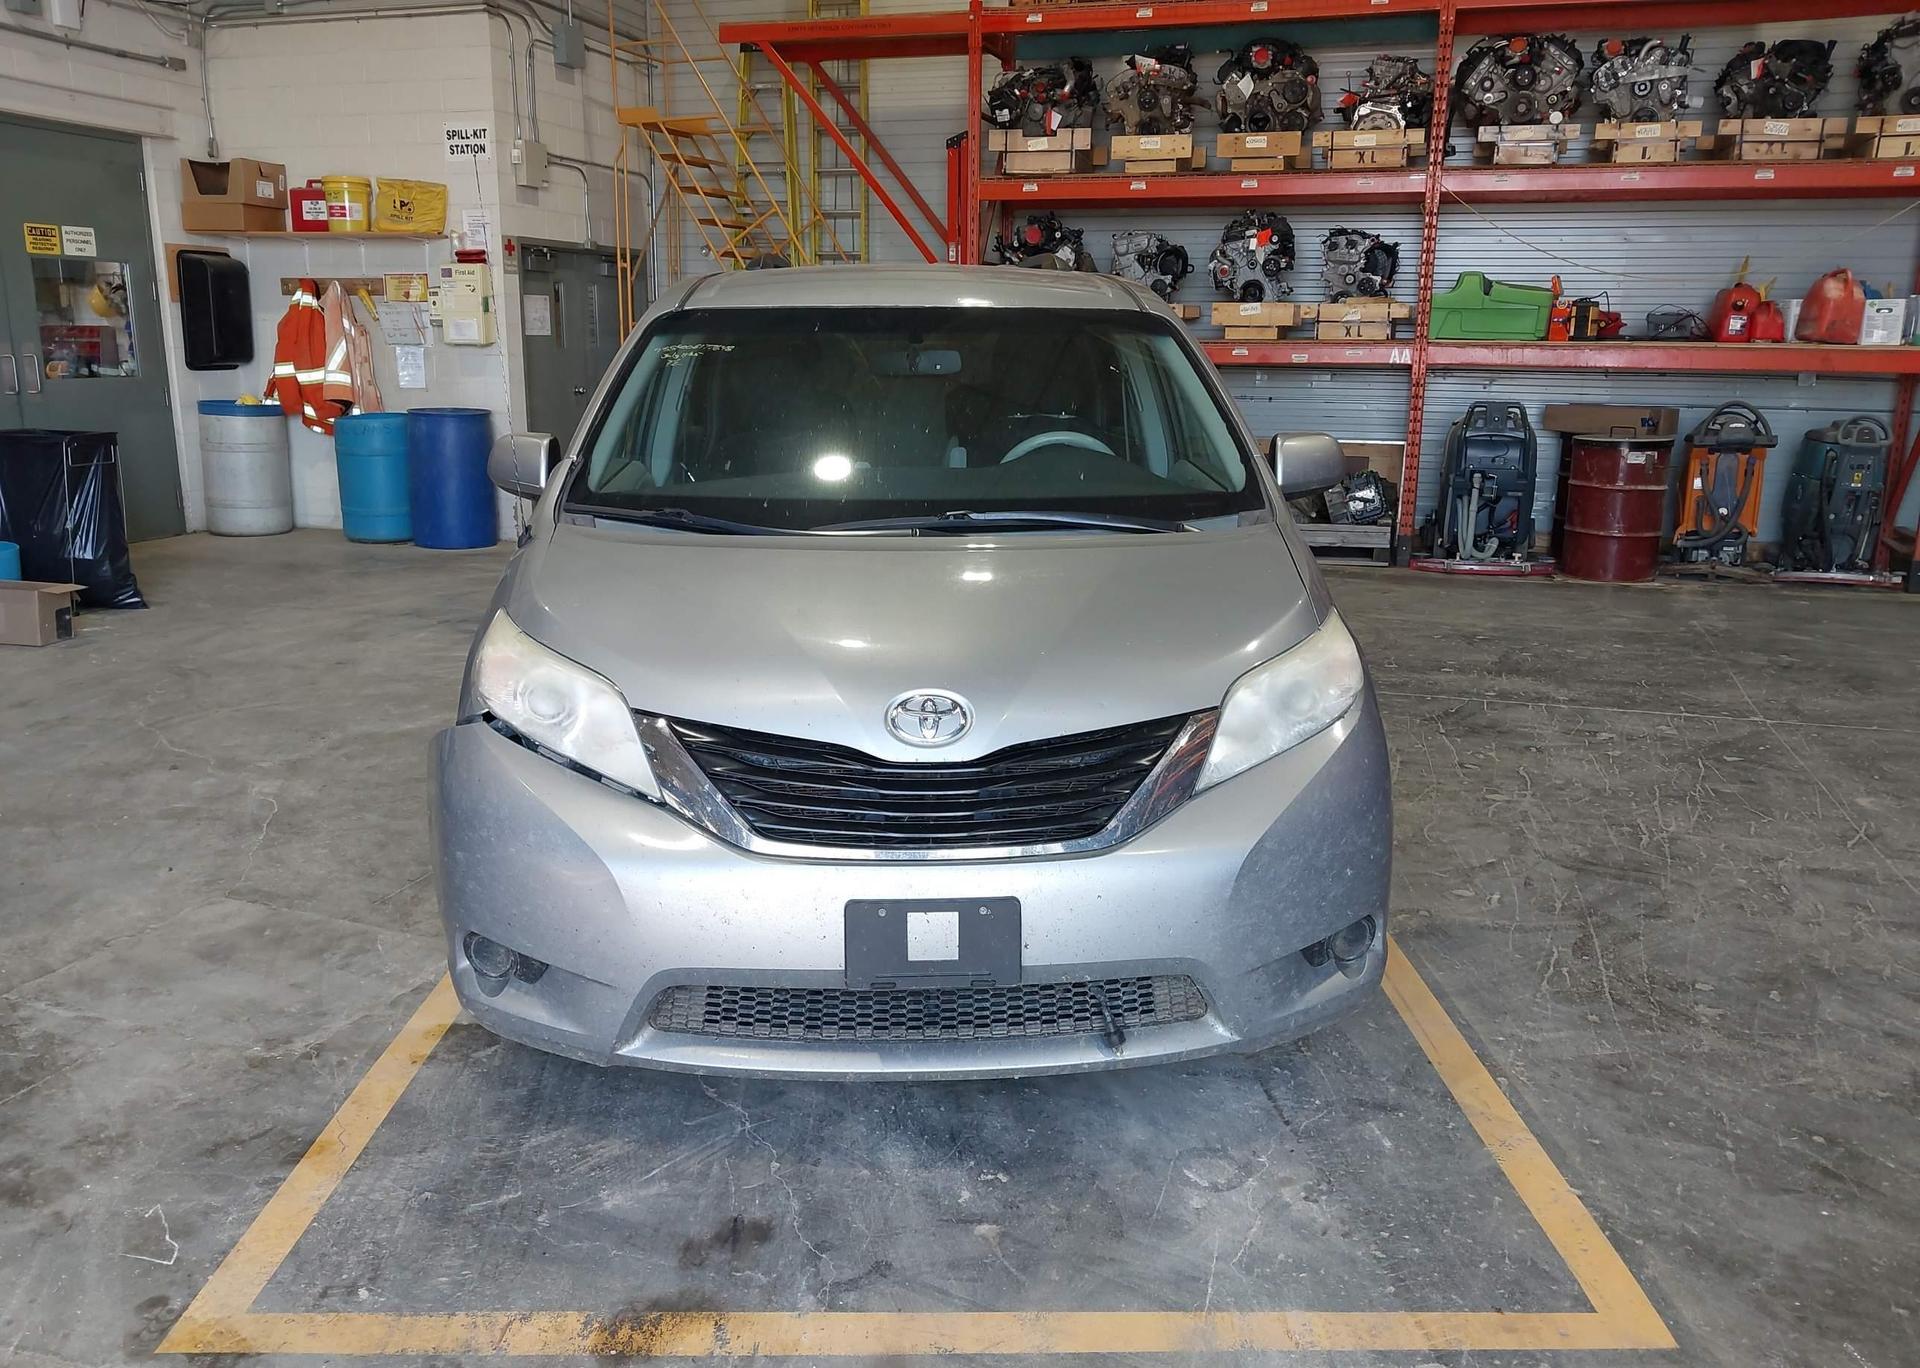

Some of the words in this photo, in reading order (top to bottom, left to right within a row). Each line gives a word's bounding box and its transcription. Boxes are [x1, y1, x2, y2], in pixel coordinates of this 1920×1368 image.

[446, 128, 487, 140] SPILL-KIT
[449, 143, 486, 155] STATION
[27, 227, 56, 237] CAUTION
[1389, 347, 1412, 364] AA
